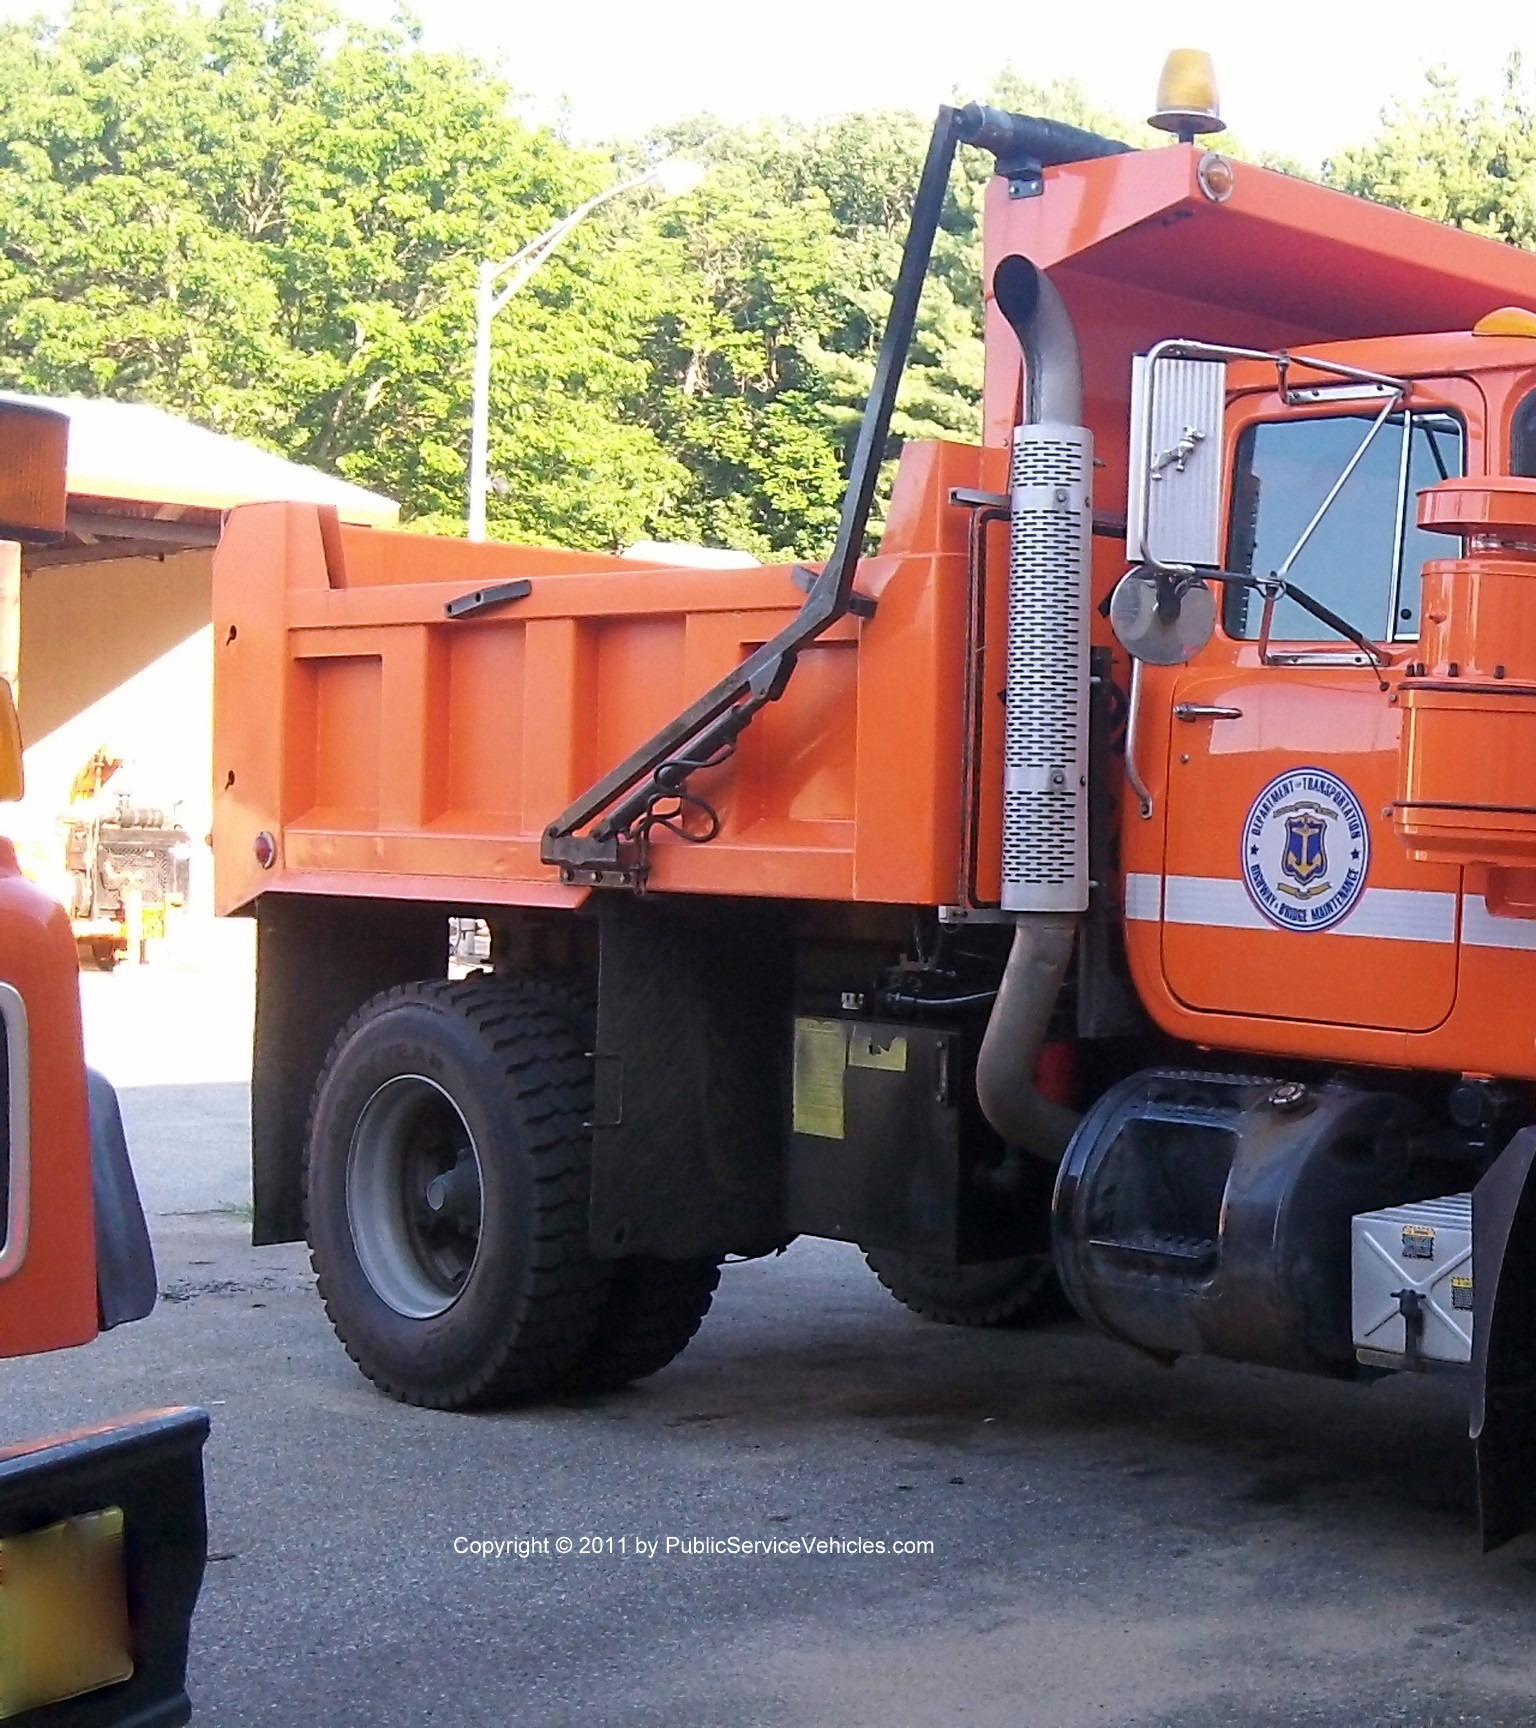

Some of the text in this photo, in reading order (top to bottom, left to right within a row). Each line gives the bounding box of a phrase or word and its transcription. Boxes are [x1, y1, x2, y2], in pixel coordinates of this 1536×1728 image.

[1251, 777, 1361, 839] DEPARTMENT TRANSPORTATION
[1310, 867, 1359, 920] MAINTENANCE
